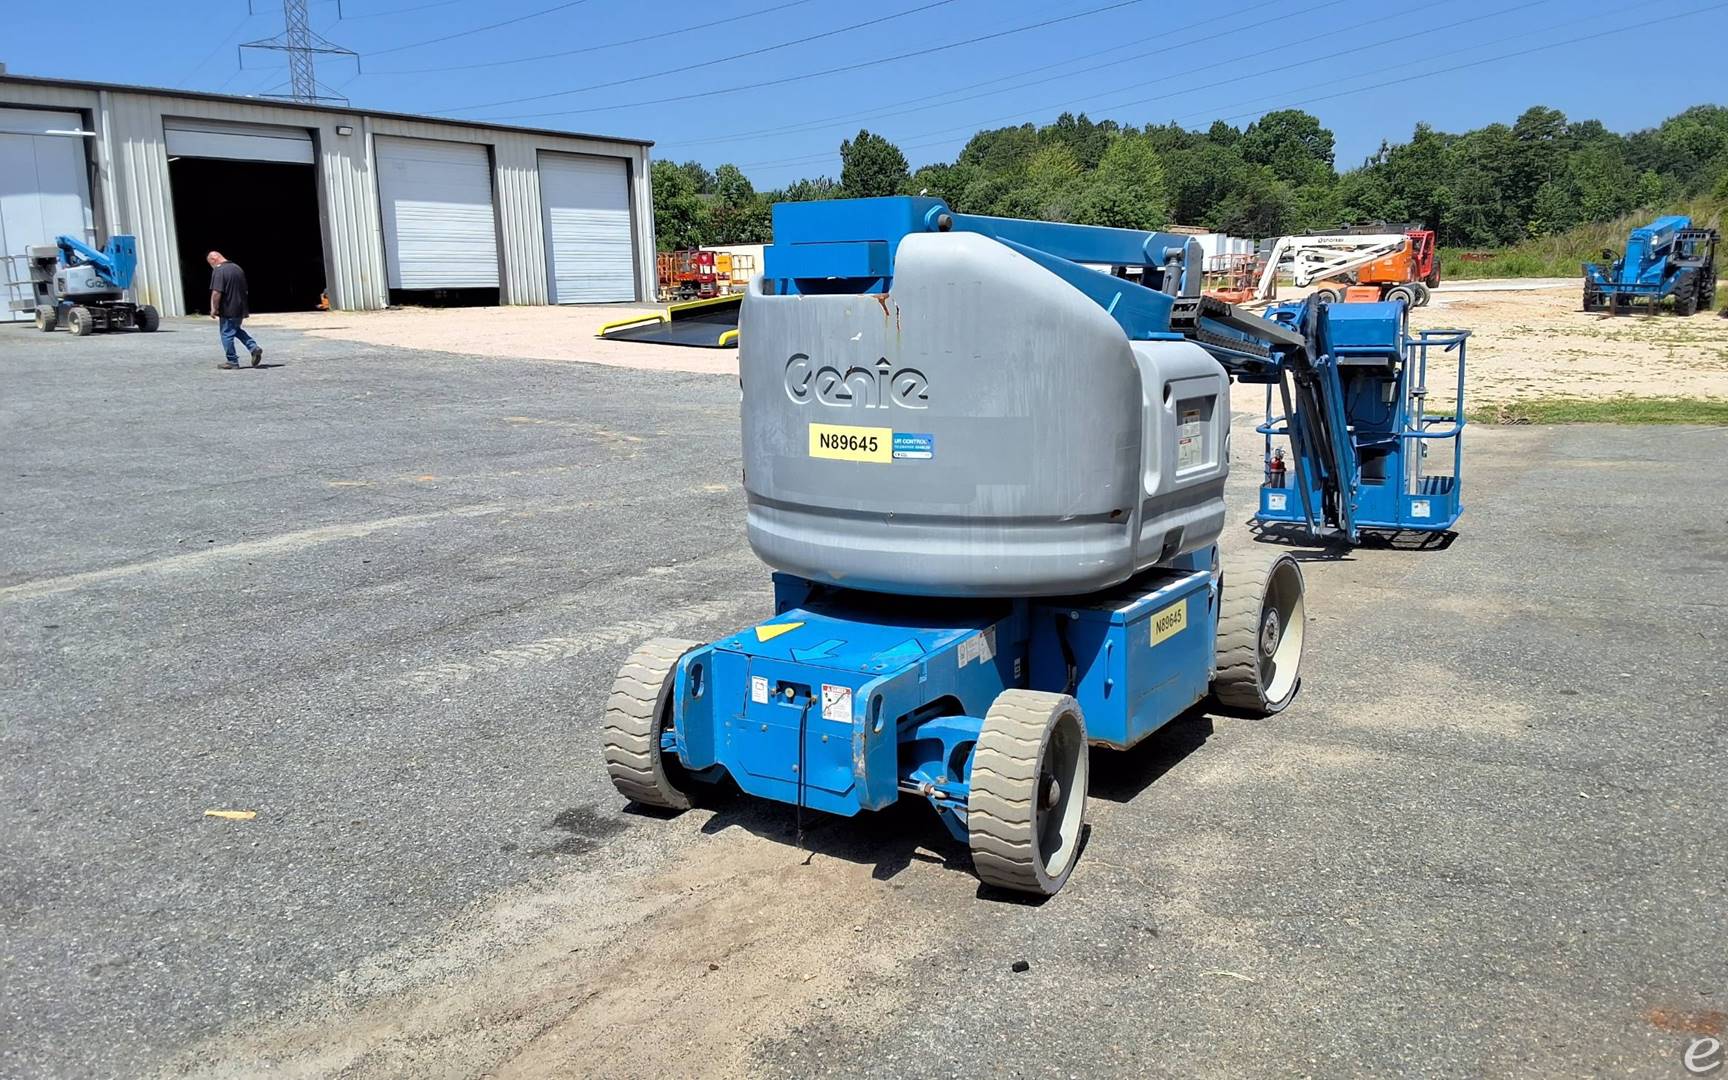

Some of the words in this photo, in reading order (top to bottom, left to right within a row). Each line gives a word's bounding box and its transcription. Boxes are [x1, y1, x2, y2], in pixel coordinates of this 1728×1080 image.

[784, 352, 929, 409] Genie
[820, 433, 878, 452] N89645
[1156, 608, 1182, 635] N89645
